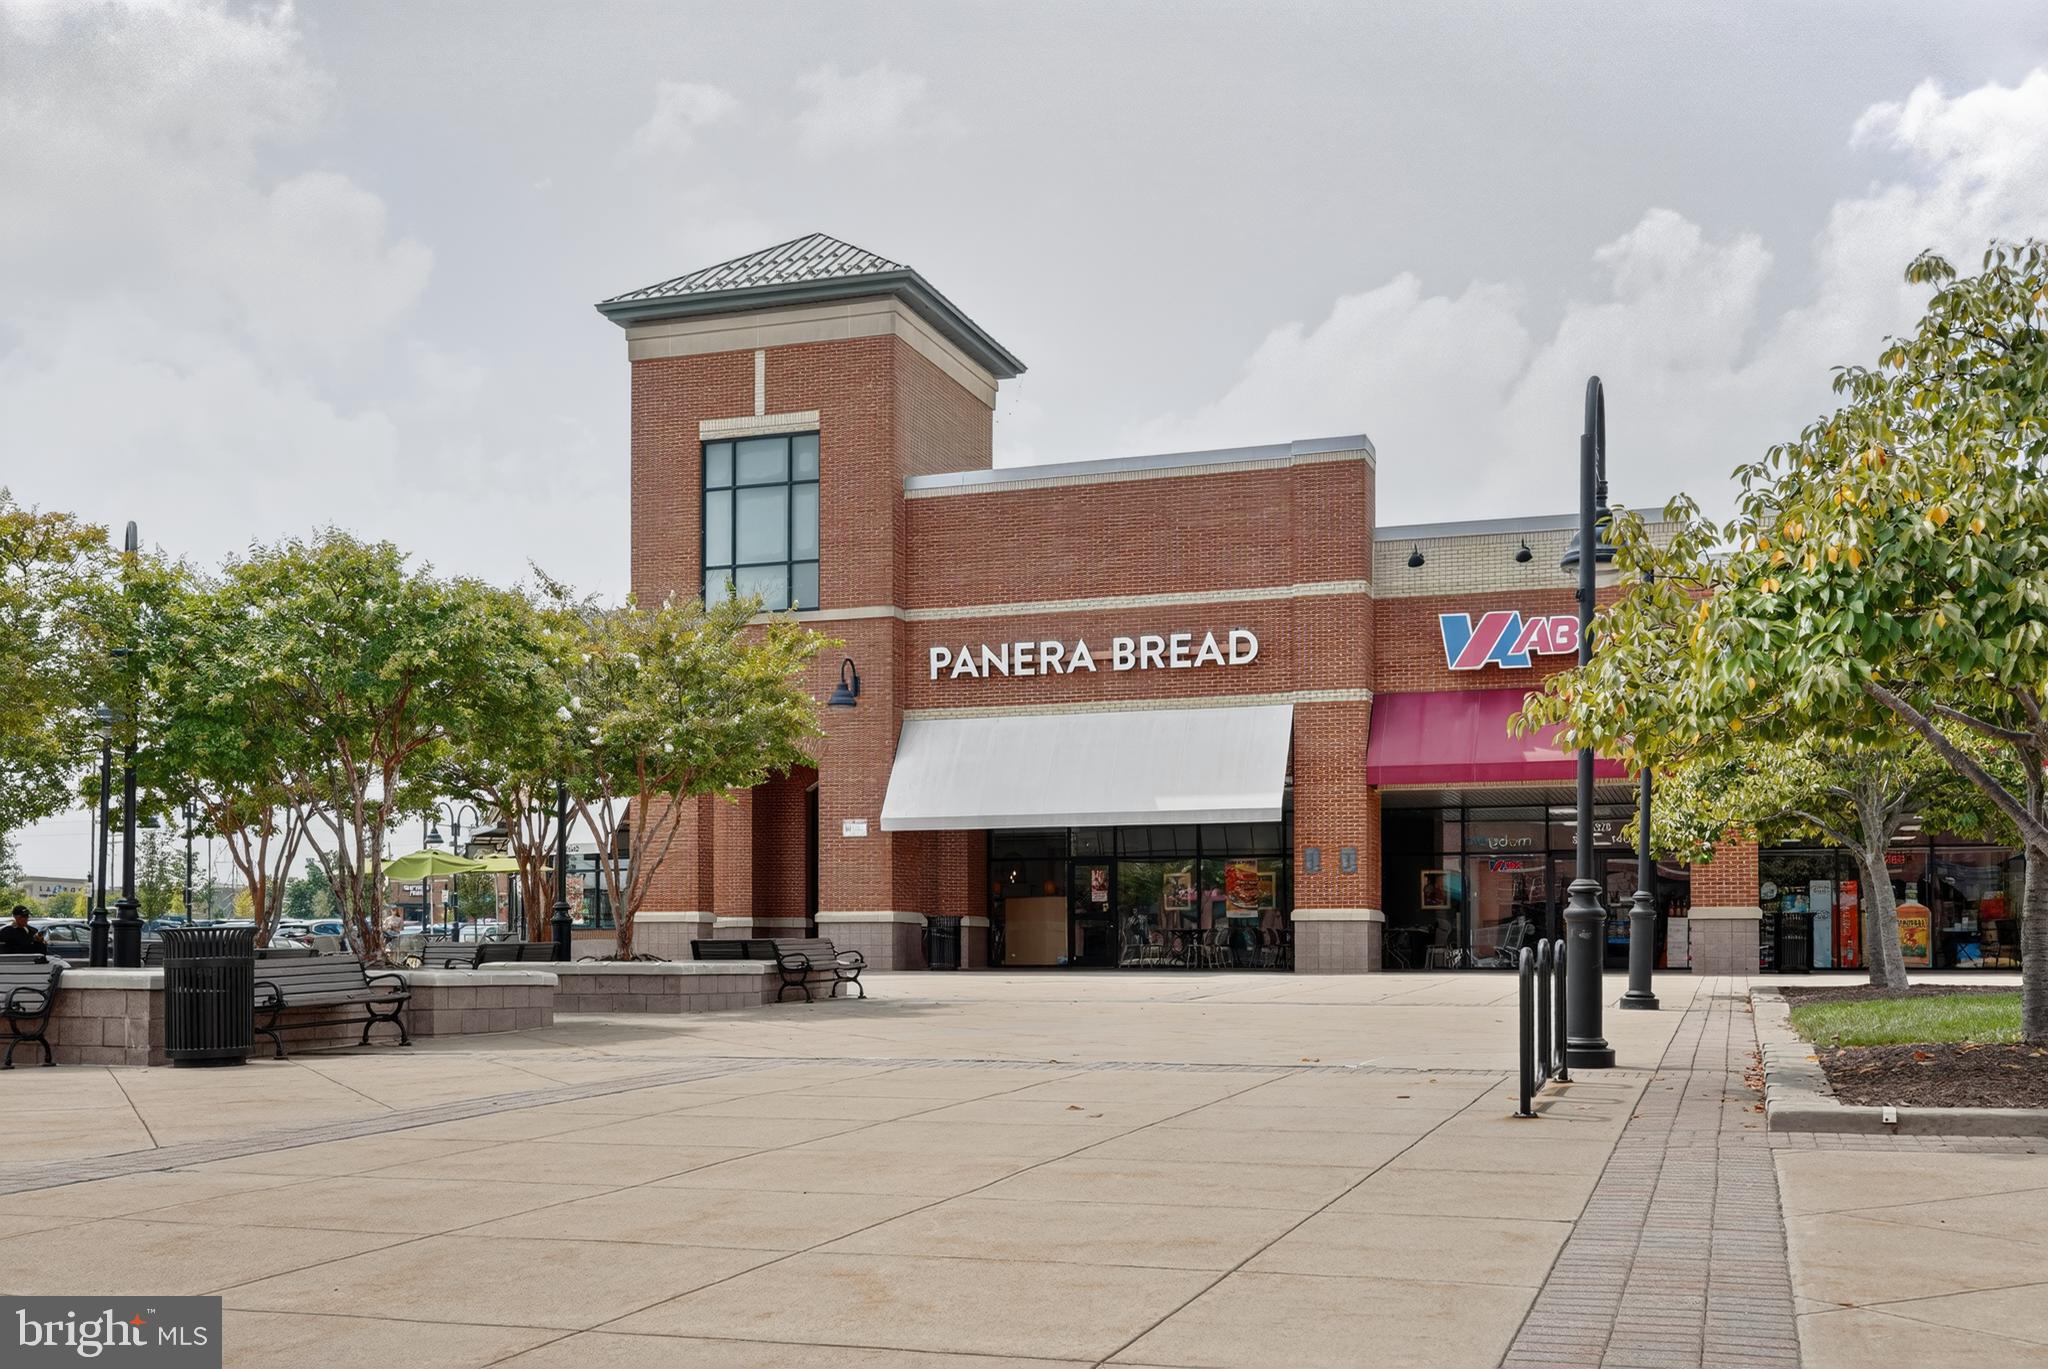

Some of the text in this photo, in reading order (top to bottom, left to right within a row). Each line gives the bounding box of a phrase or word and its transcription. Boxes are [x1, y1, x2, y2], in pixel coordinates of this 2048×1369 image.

[929, 629, 1259, 680] PANERA BREAD
[1507, 615, 1580, 655] AB
